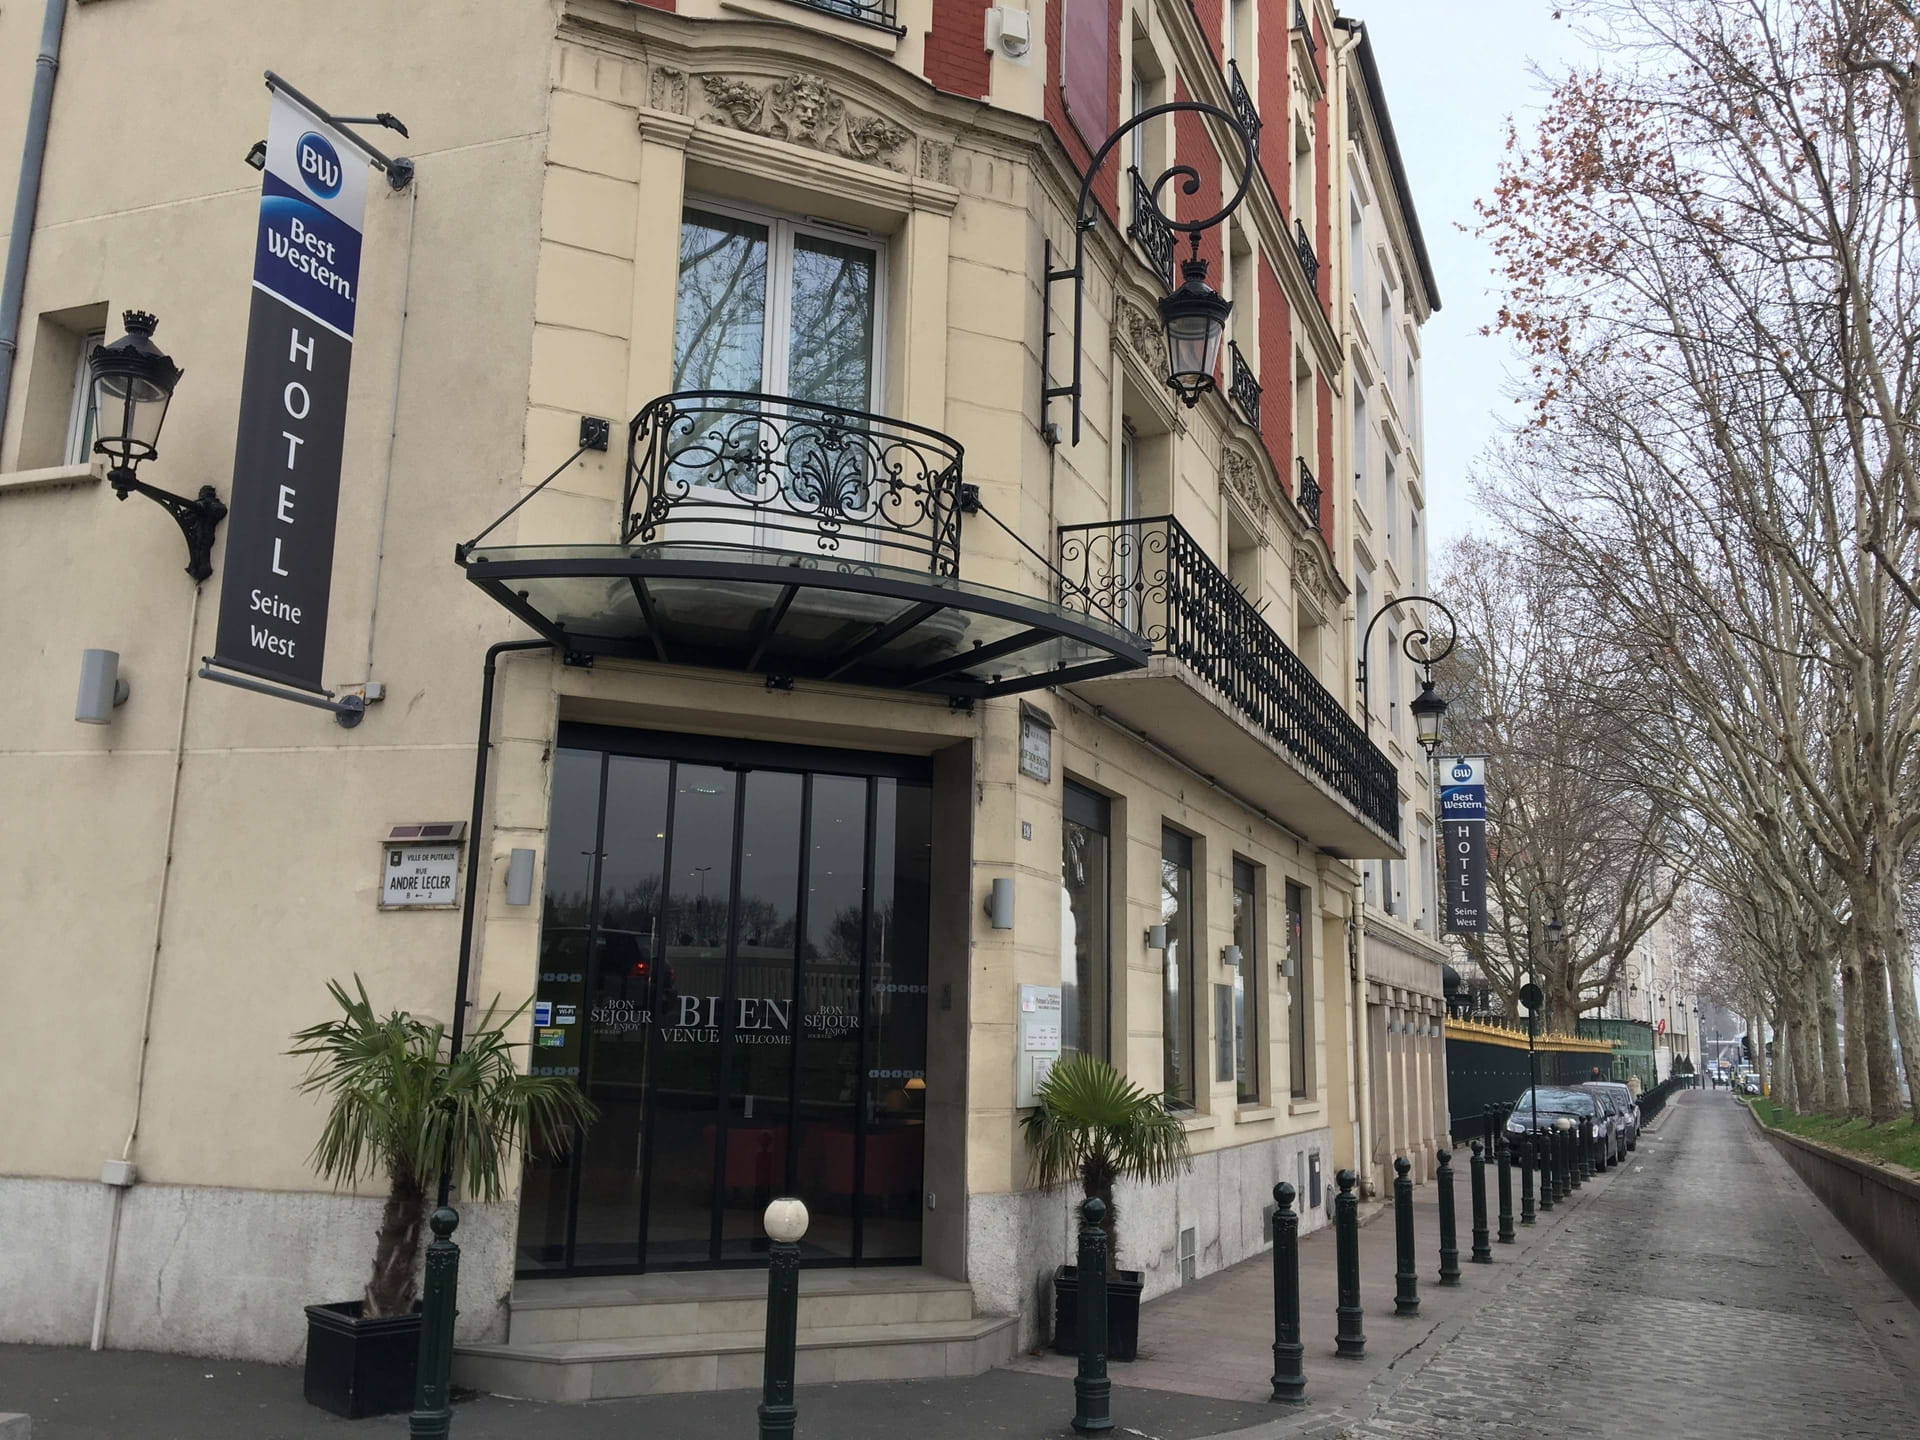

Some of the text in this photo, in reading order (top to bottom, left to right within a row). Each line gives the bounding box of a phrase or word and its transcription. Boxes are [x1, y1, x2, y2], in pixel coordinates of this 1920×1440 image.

[302, 144, 339, 187] BW
[290, 217, 336, 265] Best
[268, 227, 351, 301] Western
[272, 327, 315, 577] HOTEL
[250, 589, 301, 624] Seine
[250, 625, 295, 658] West
[1454, 769, 1471, 778] BW
[1452, 793, 1474, 801] Best
[1444, 801, 1482, 809] Western
[1458, 826, 1470, 902] HOTEL
[422, 876, 451, 889] LECLER
[1454, 907, 1478, 915] Seine
[607, 999, 635, 1010] BON
[818, 1005, 843, 1016] BON
[590, 1007, 653, 1026] SÉJOUR
[674, 995, 793, 1030] BI EN
[614, 1022, 640, 1033] ENJOY
[804, 1012, 860, 1031] SÉJOUR
[660, 1028, 720, 1043] VENUE
[734, 1034, 792, 1045] WELCOME
[824, 1027, 849, 1037] ENJOY
